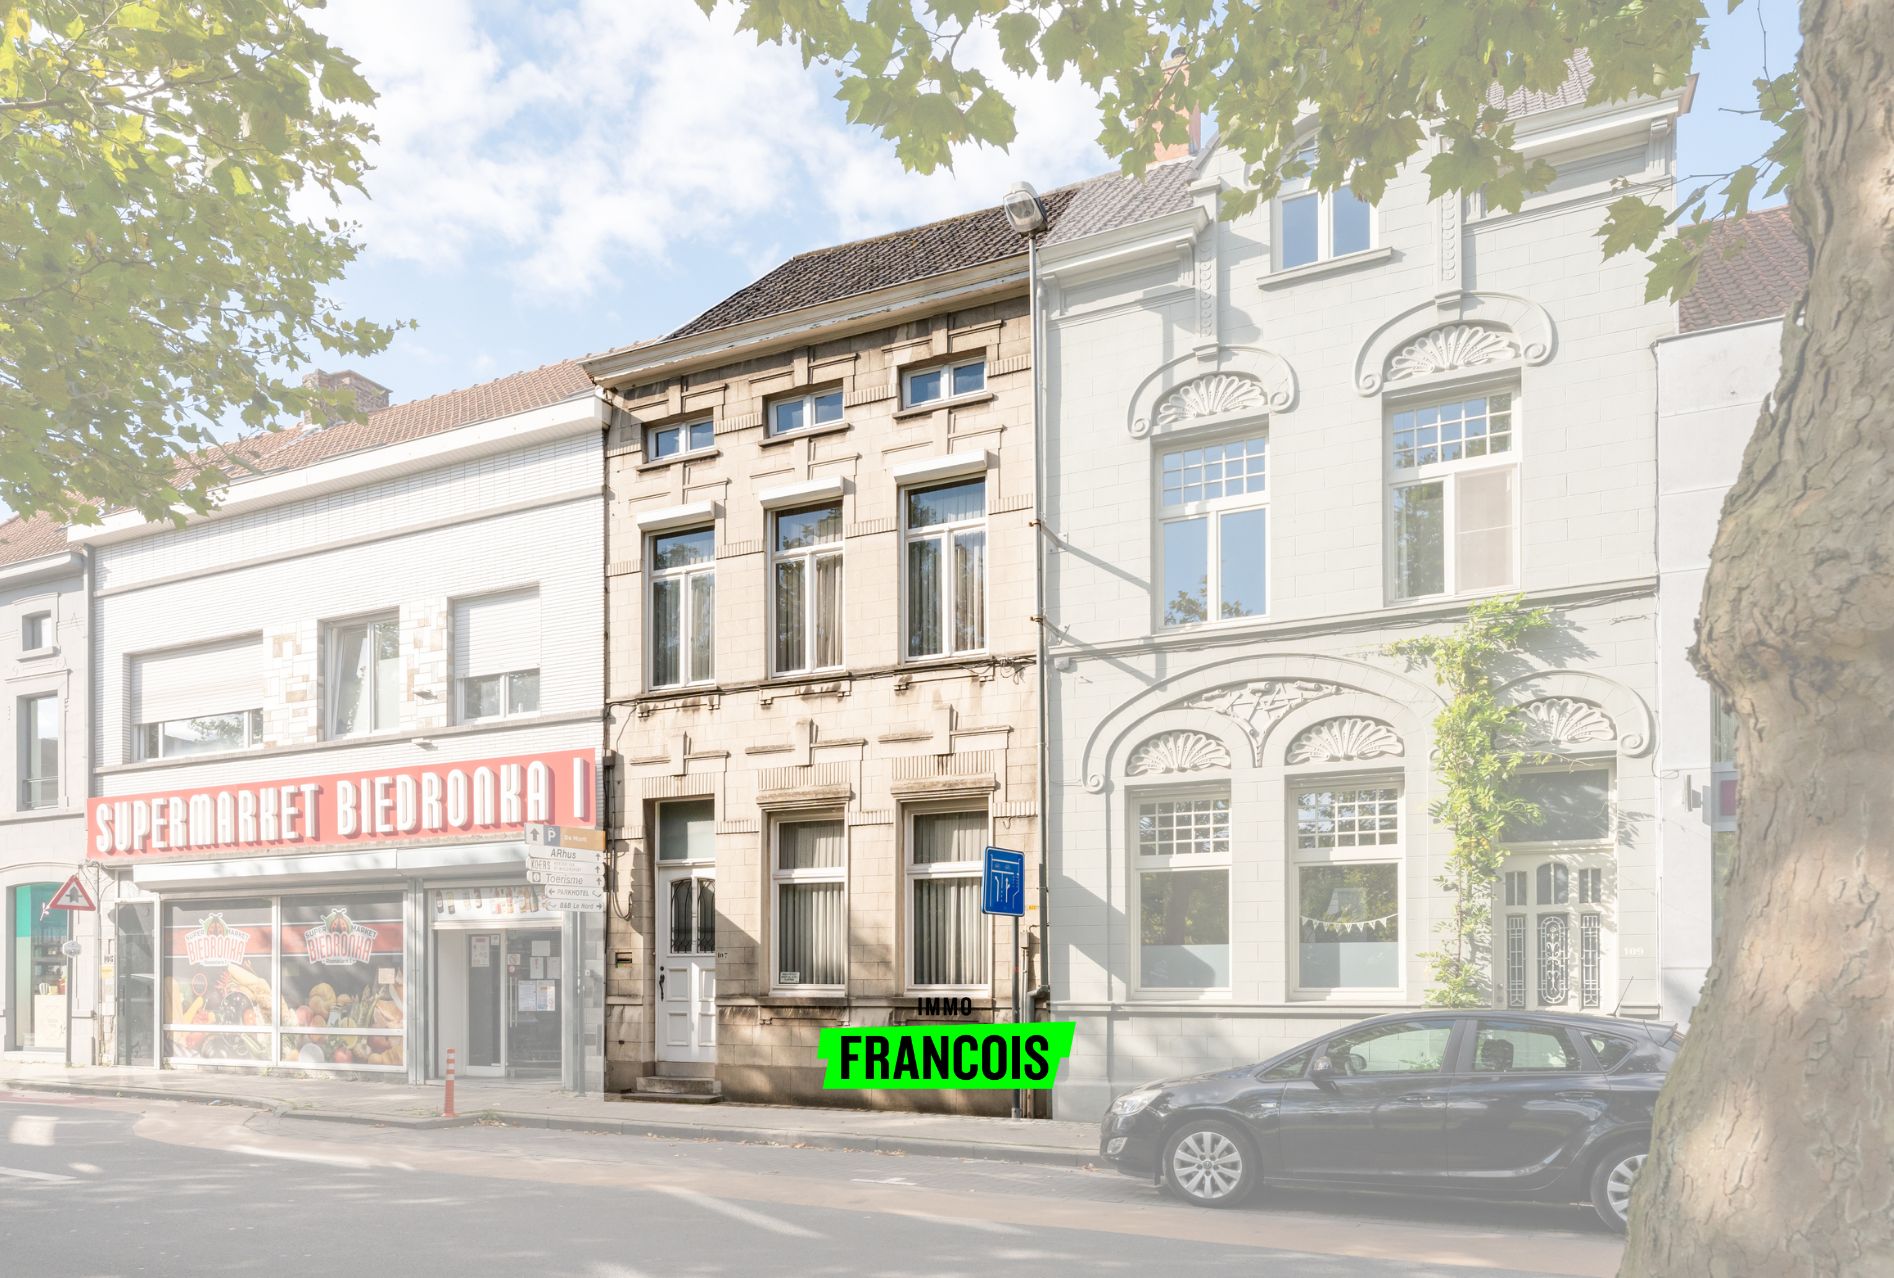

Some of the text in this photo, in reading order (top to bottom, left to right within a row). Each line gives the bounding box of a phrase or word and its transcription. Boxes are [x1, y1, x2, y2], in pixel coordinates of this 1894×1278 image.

[95, 782, 321, 853] SUPERMARKET
[336, 760, 550, 836] BIEDRONKA
[551, 848, 577, 860] ARhus
[546, 873, 584, 885] Toerisme
[557, 888, 590, 897] PARKHOTEL
[305, 925, 377, 938] SUPER MARKET
[188, 935, 246, 963] BIEDRONKA
[307, 932, 373, 961] BIEDRONKA
